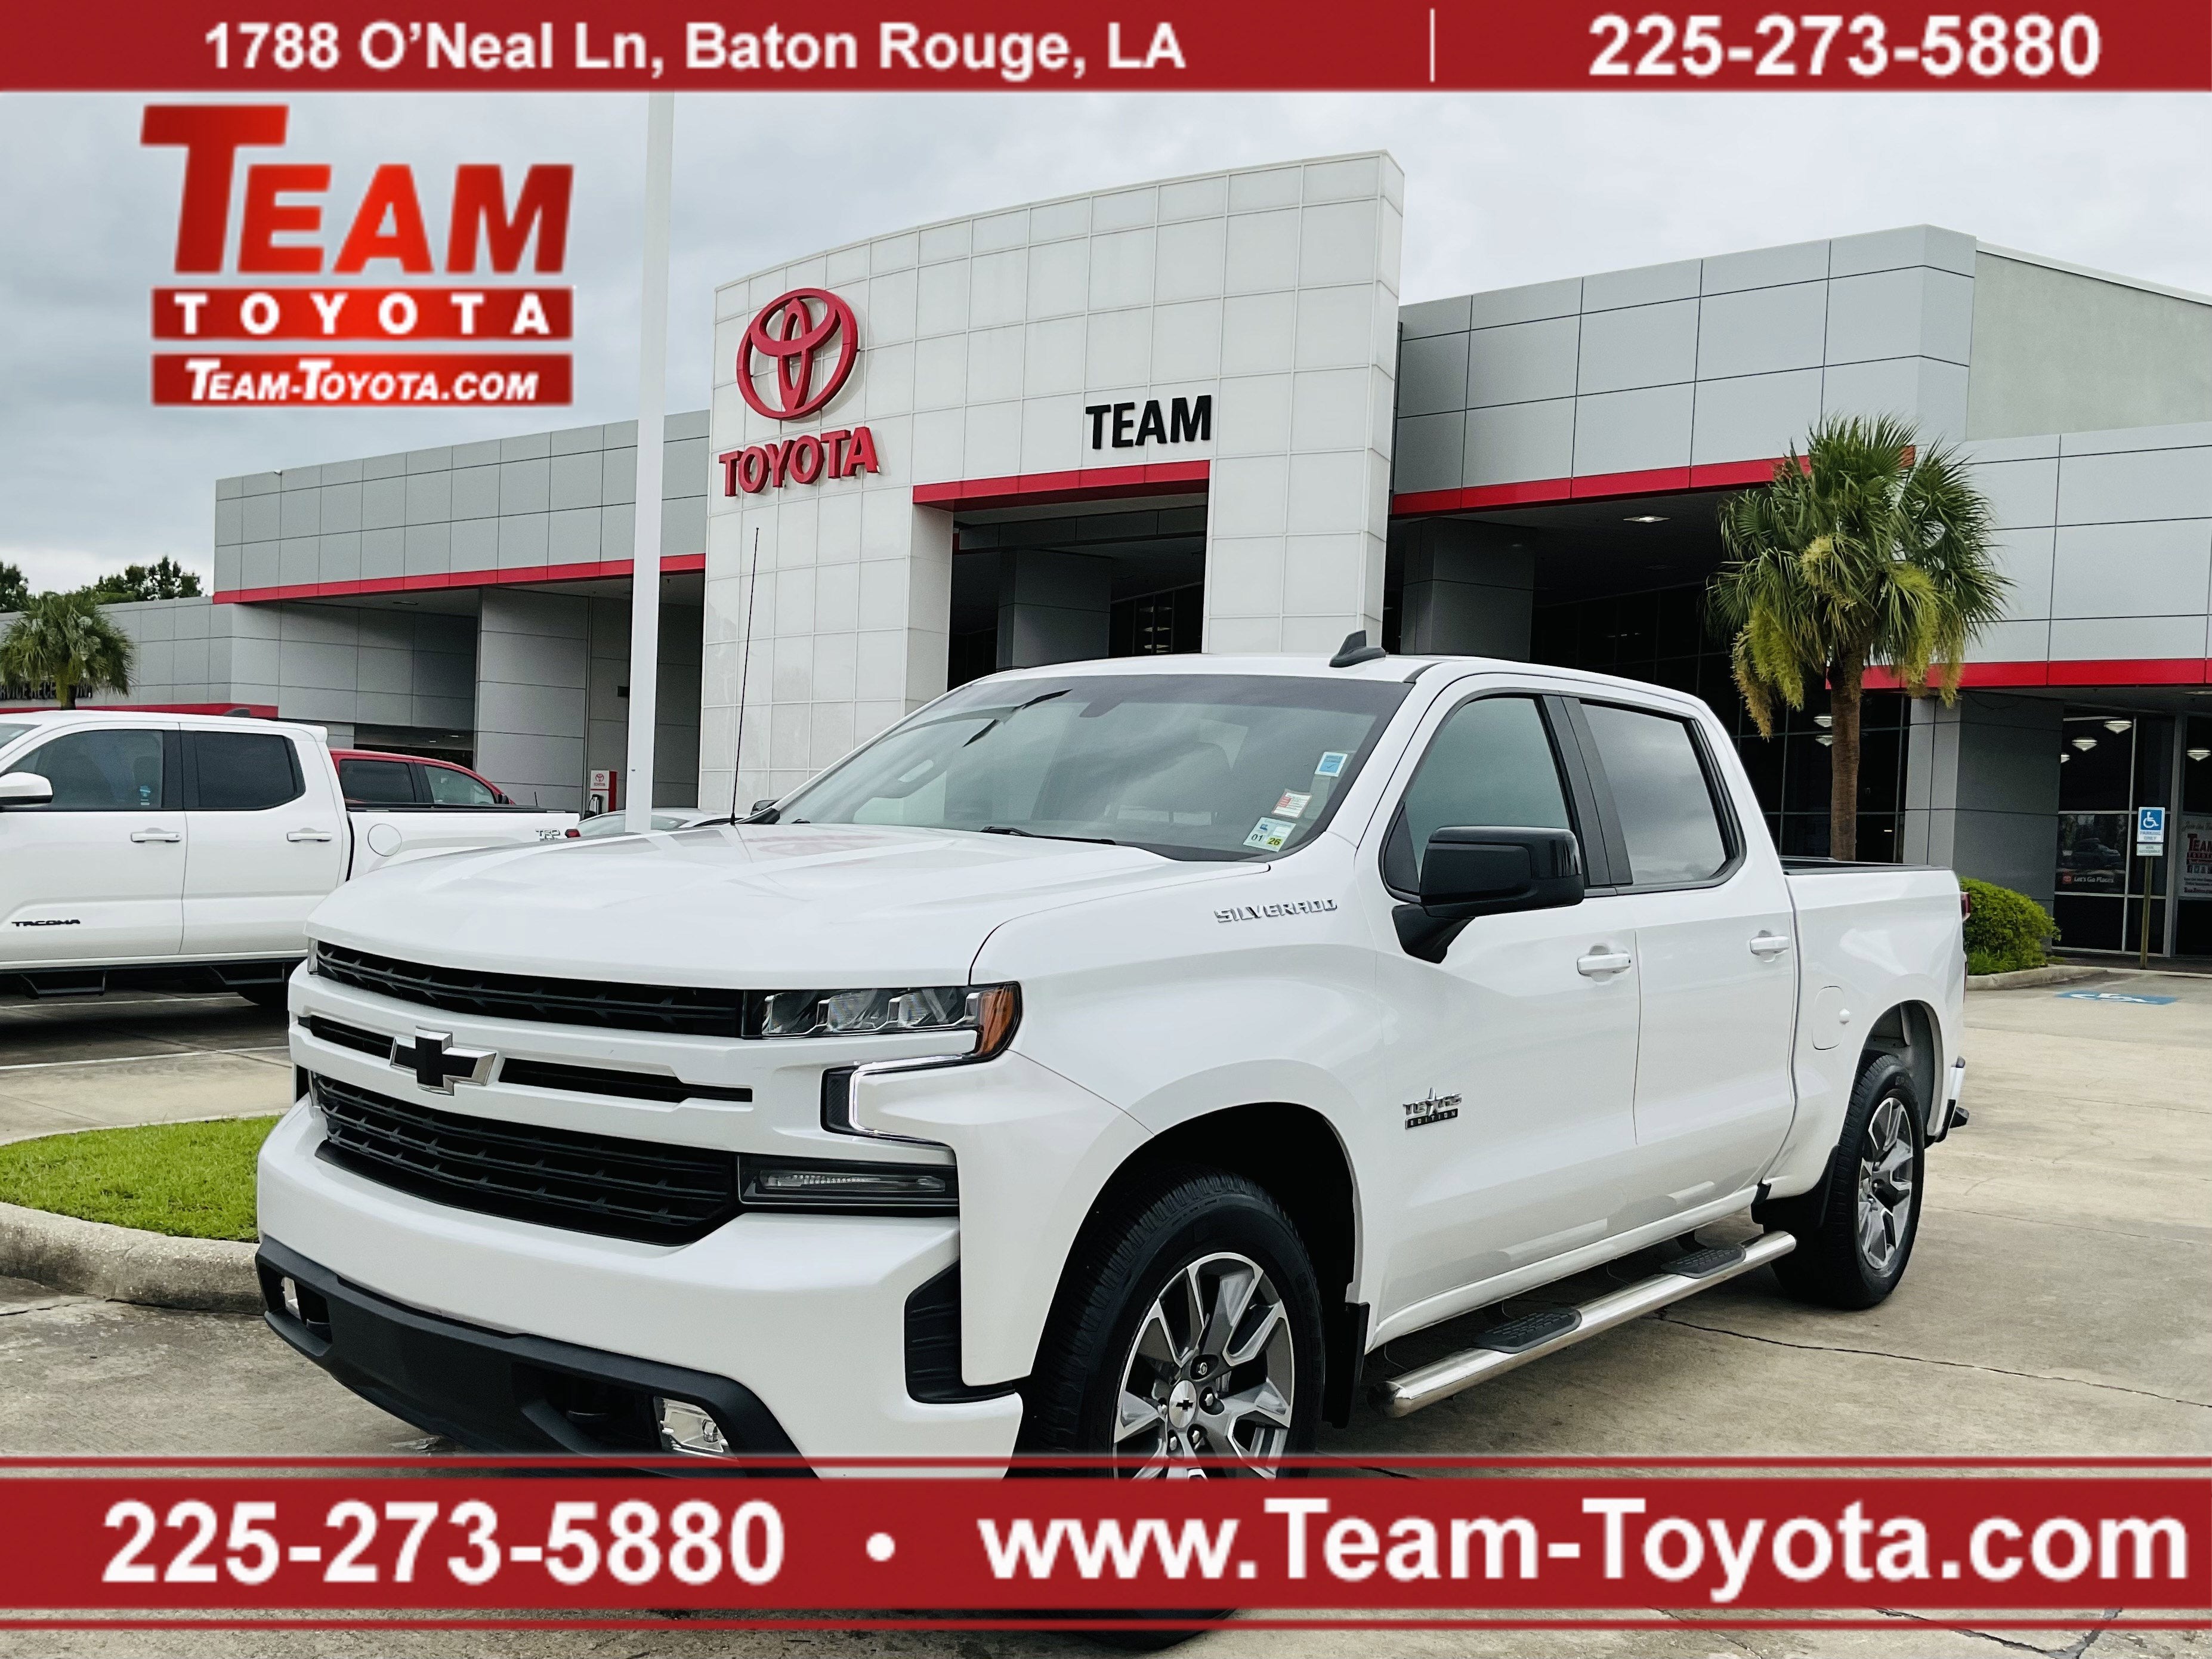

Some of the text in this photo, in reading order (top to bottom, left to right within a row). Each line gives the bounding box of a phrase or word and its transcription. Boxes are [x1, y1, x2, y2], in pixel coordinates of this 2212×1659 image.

[1085, 395, 1212, 449] TEAM
[719, 427, 879, 496] TOYOTA
[535, 829, 560, 839] TRD
[1268, 838, 1281, 846] 26
[1214, 898, 1337, 923] SILVERADO
